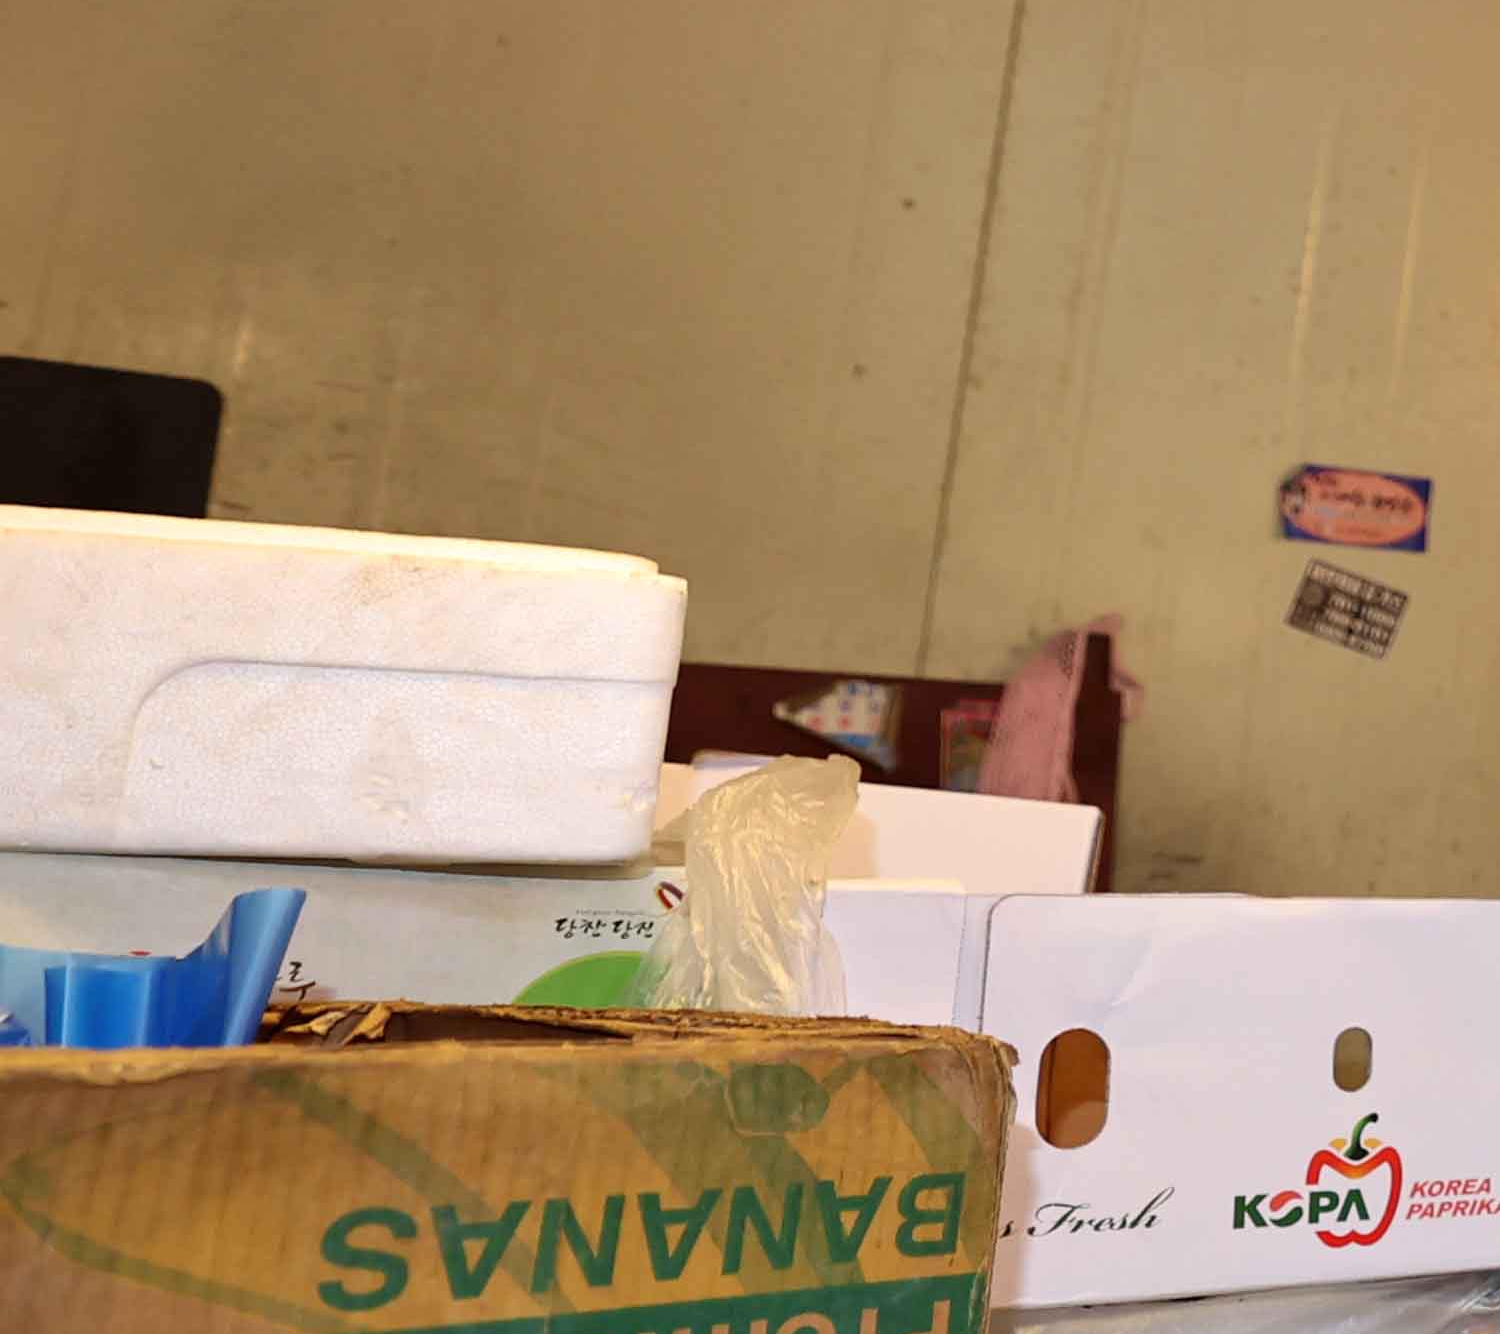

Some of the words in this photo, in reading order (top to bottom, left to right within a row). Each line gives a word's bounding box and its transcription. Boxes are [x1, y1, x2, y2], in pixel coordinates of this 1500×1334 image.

[1232, 1187, 1370, 1230] KOPA
[1408, 1177, 1493, 1198] KOREA
[1027, 1186, 1176, 1237] Fresh
[318, 1172, 967, 1311] BANANAS
